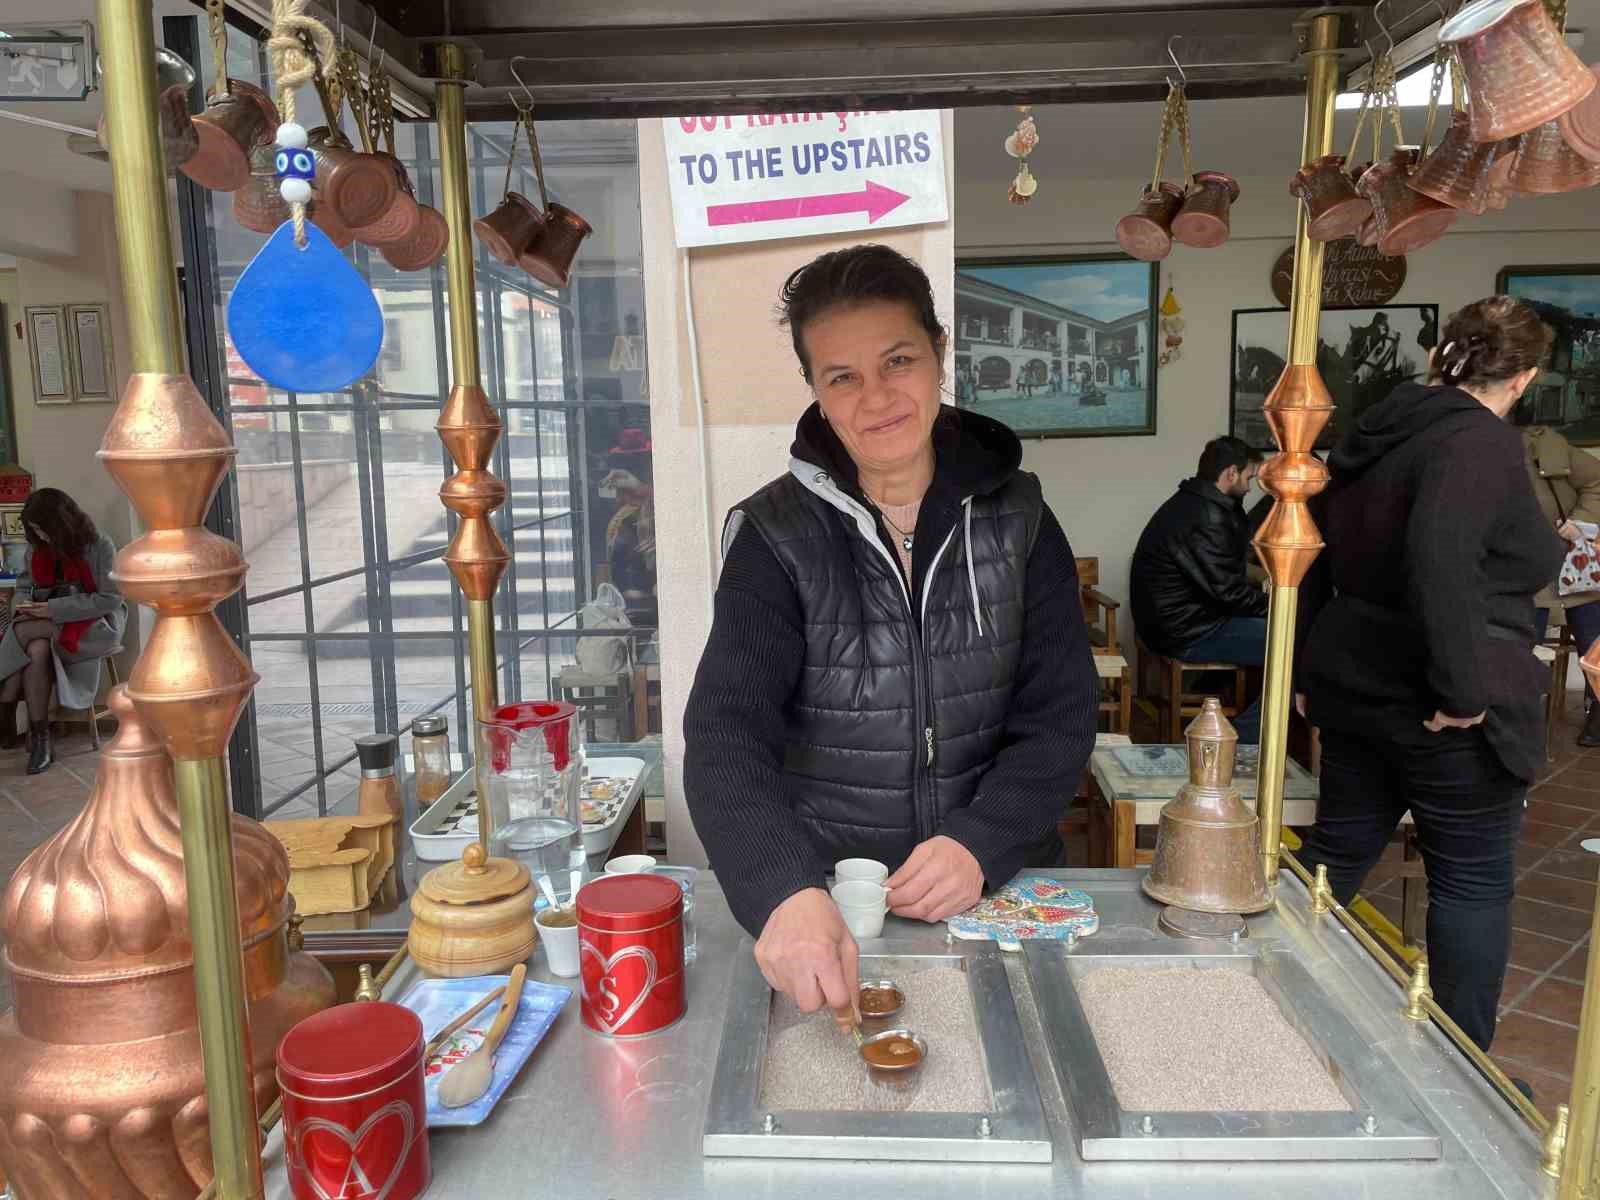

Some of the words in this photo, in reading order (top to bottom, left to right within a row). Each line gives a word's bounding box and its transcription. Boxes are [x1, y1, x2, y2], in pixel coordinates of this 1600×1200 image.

[680, 154, 718, 186] TO
[726, 147, 784, 182] THE
[792, 131, 931, 176] UPSTAIRS
[333, 1155, 381, 1199] A
